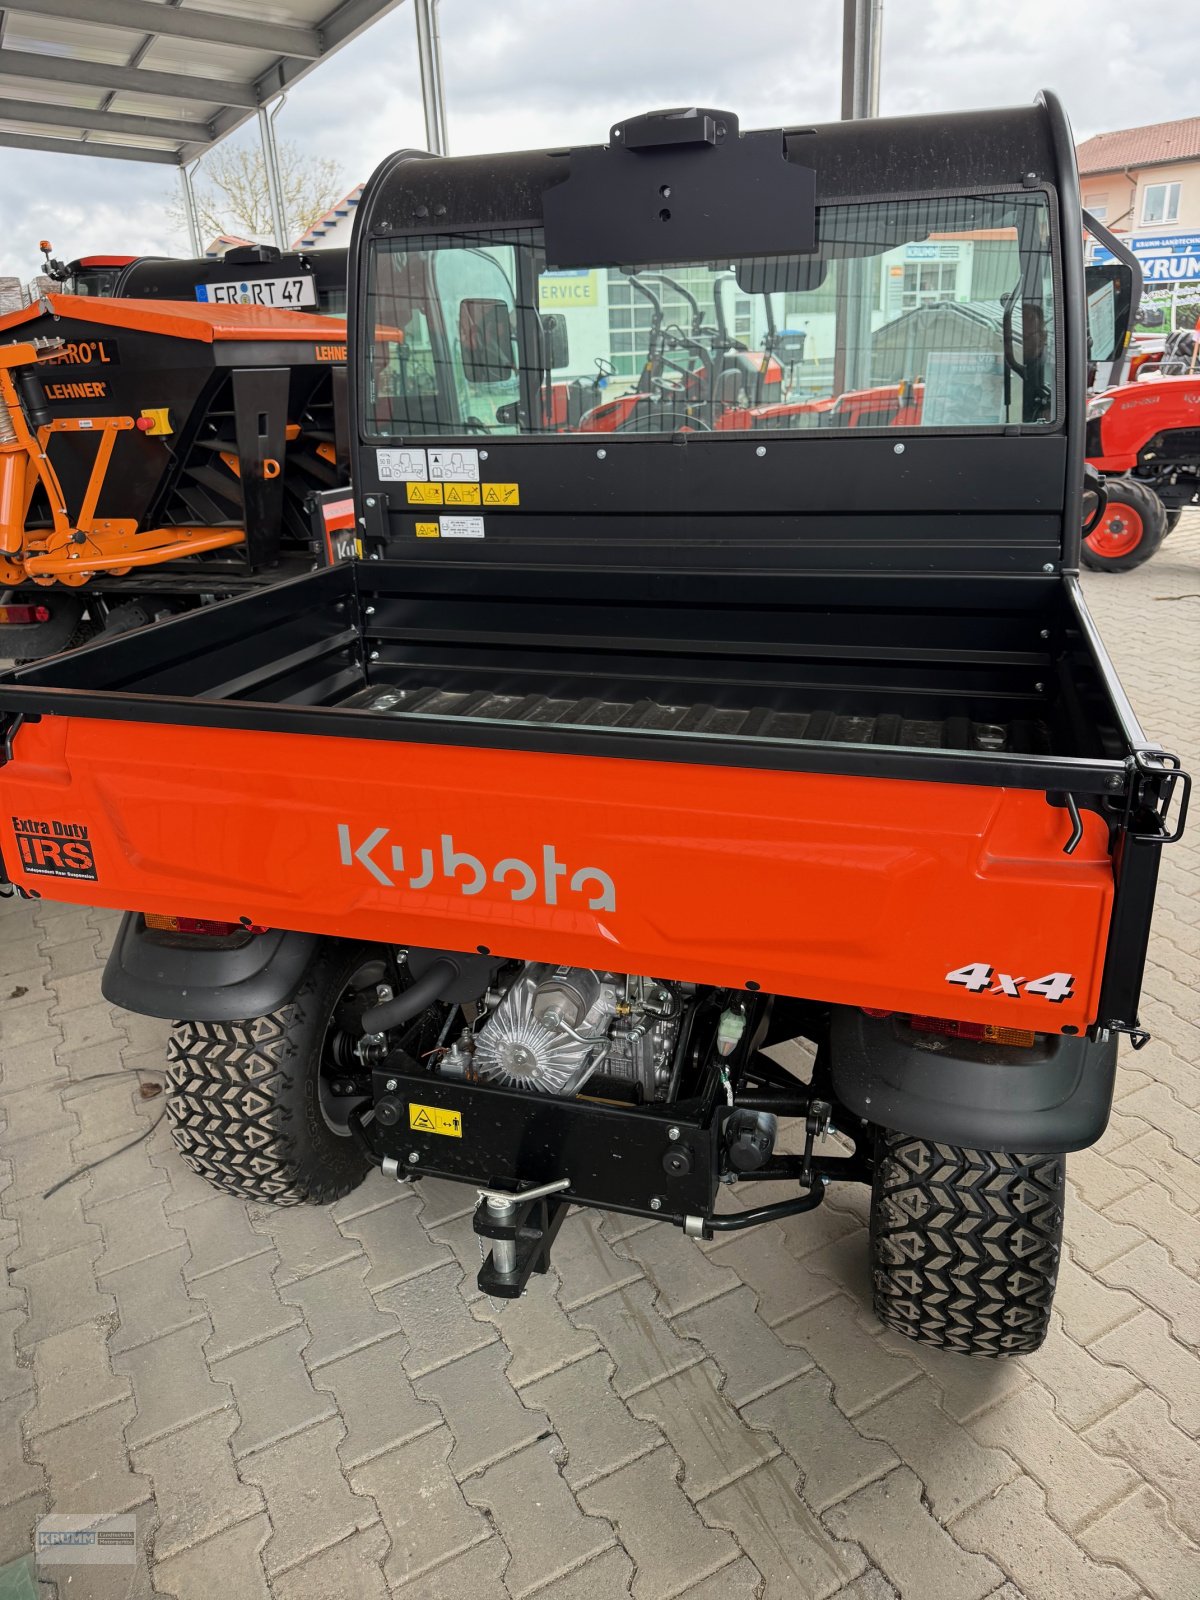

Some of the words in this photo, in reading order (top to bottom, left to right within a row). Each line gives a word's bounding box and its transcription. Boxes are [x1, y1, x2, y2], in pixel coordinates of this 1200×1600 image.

[252, 283, 276, 305] RT
[282, 280, 303, 303] 47
[541, 285, 591, 299] ERVICE
[98, 341, 110, 362] L
[315, 343, 347, 360] LEHNE
[12, 816, 50, 835] Extra
[52, 821, 88, 839] Duty
[19, 837, 93, 870] IRS
[26, 866, 54, 876] Independent
[67, 871, 95, 879] Suspension
[337, 824, 616, 912] Kubota
[945, 962, 1075, 1003] 4x4
